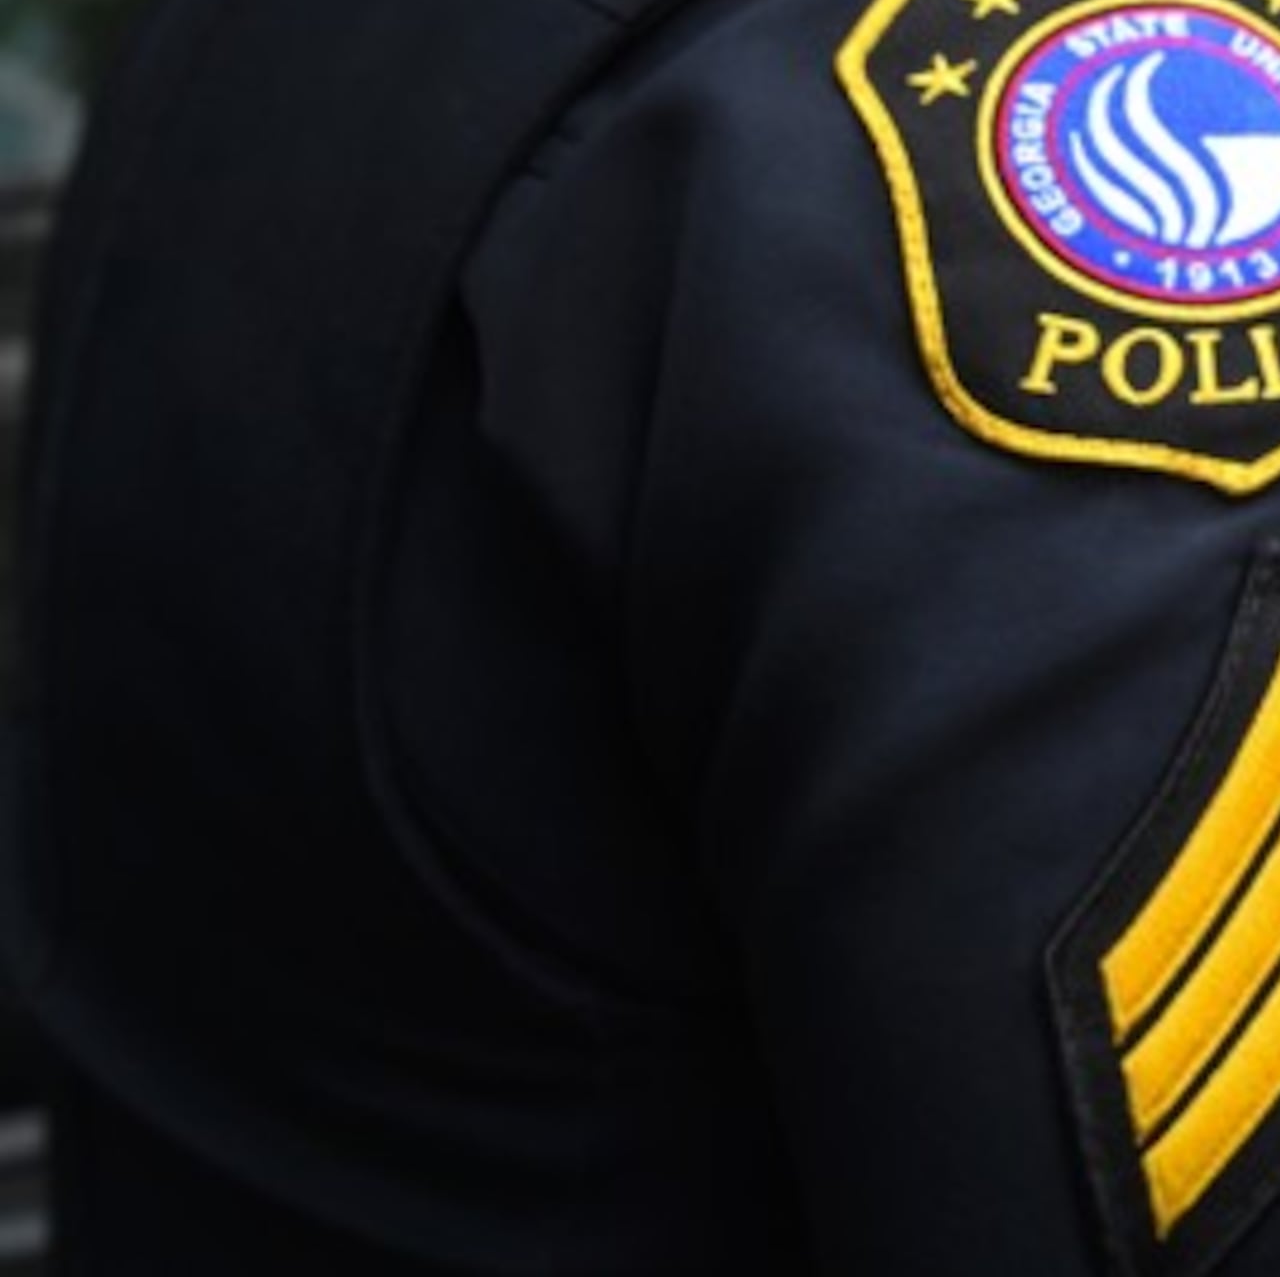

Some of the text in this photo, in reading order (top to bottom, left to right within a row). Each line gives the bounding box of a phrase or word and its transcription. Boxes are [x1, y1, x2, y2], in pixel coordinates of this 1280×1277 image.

[1010, 81, 1084, 238] GEORGIA
[1066, 13, 1192, 59] STATE
[1156, 252, 1280, 292] 1913
